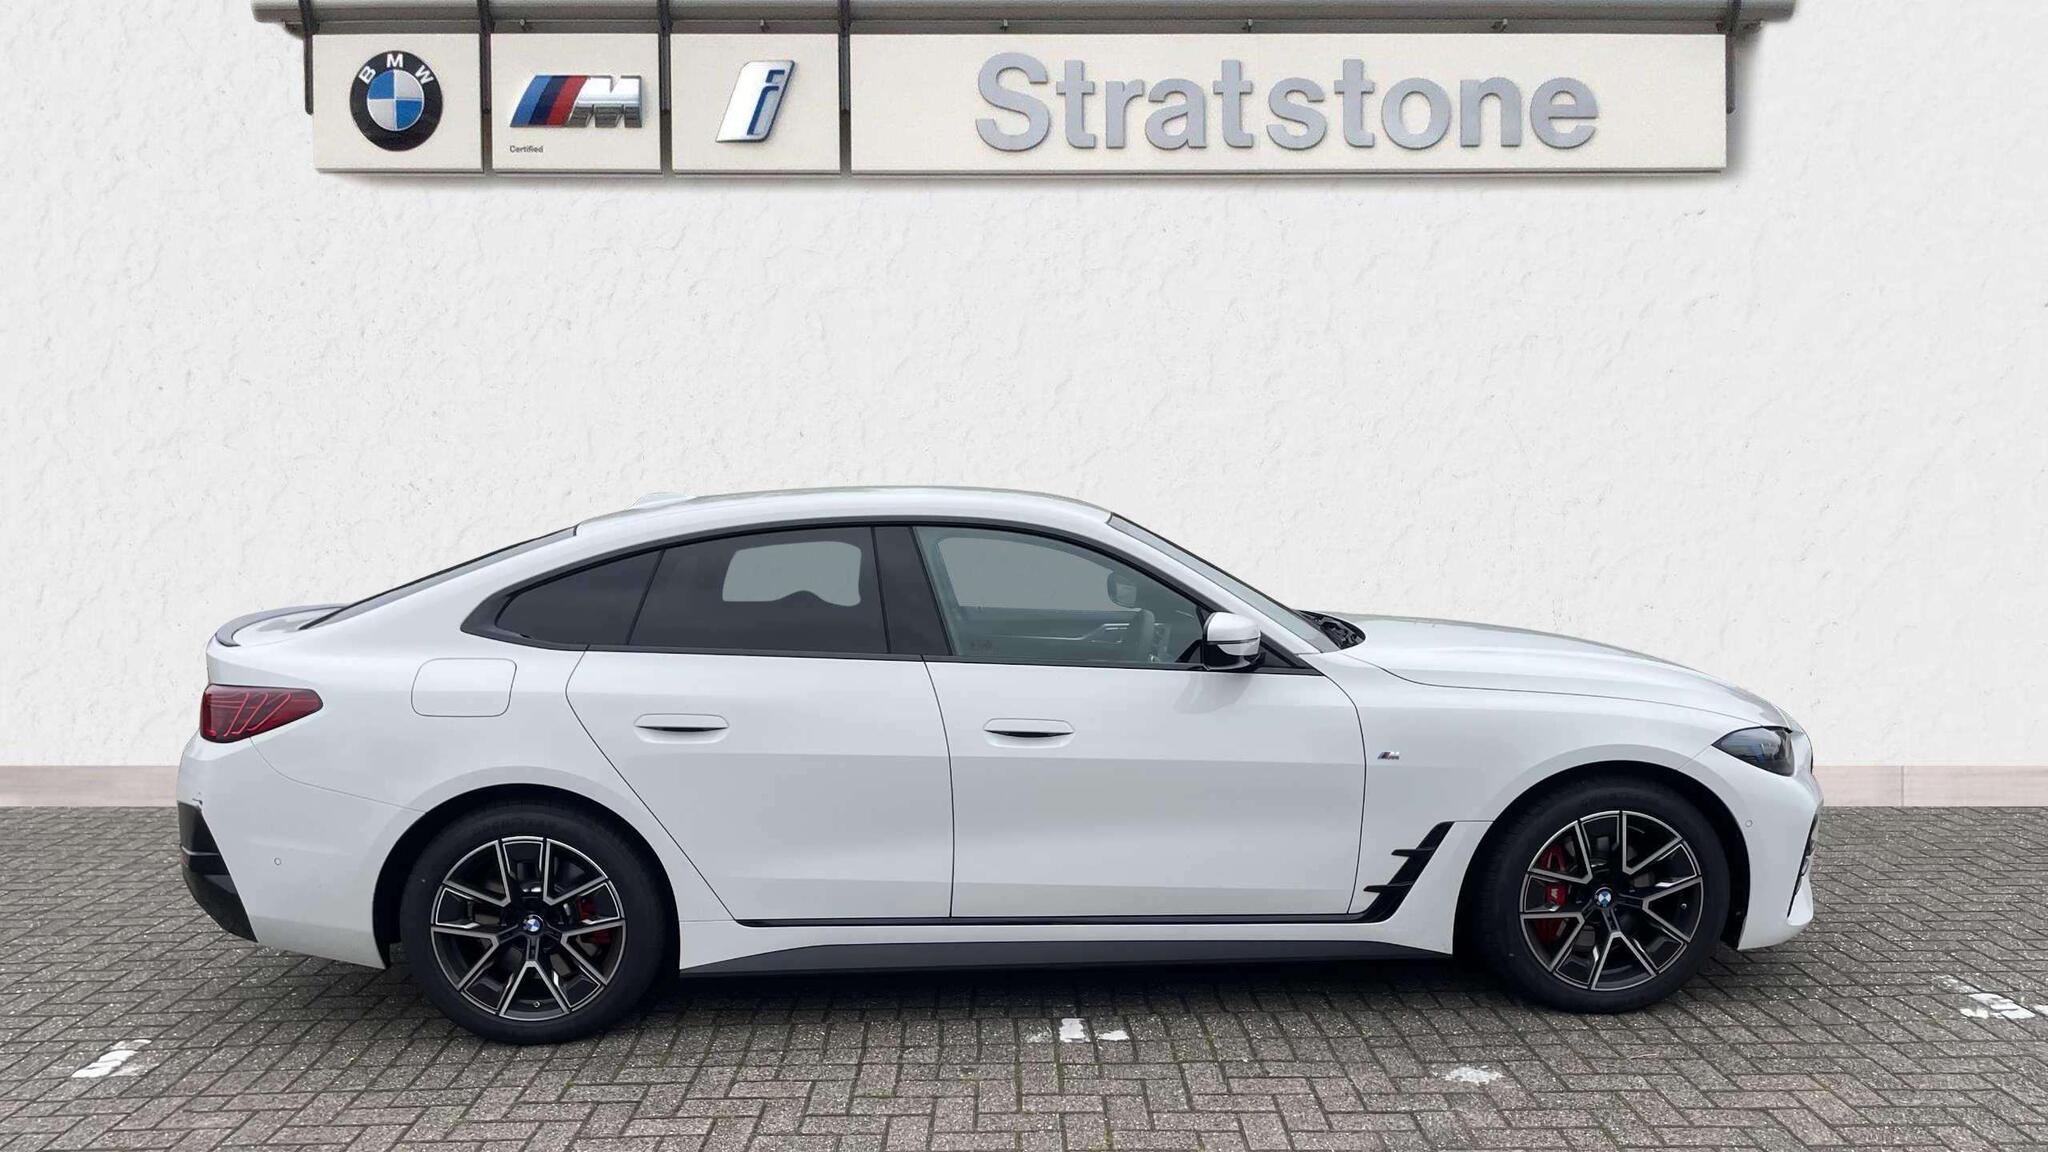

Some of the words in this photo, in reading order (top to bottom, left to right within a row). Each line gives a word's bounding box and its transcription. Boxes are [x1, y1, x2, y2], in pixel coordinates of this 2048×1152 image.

[358, 53, 435, 85] BMW
[976, 52, 1599, 152] Stratstone
[509, 145, 544, 153] Certified
